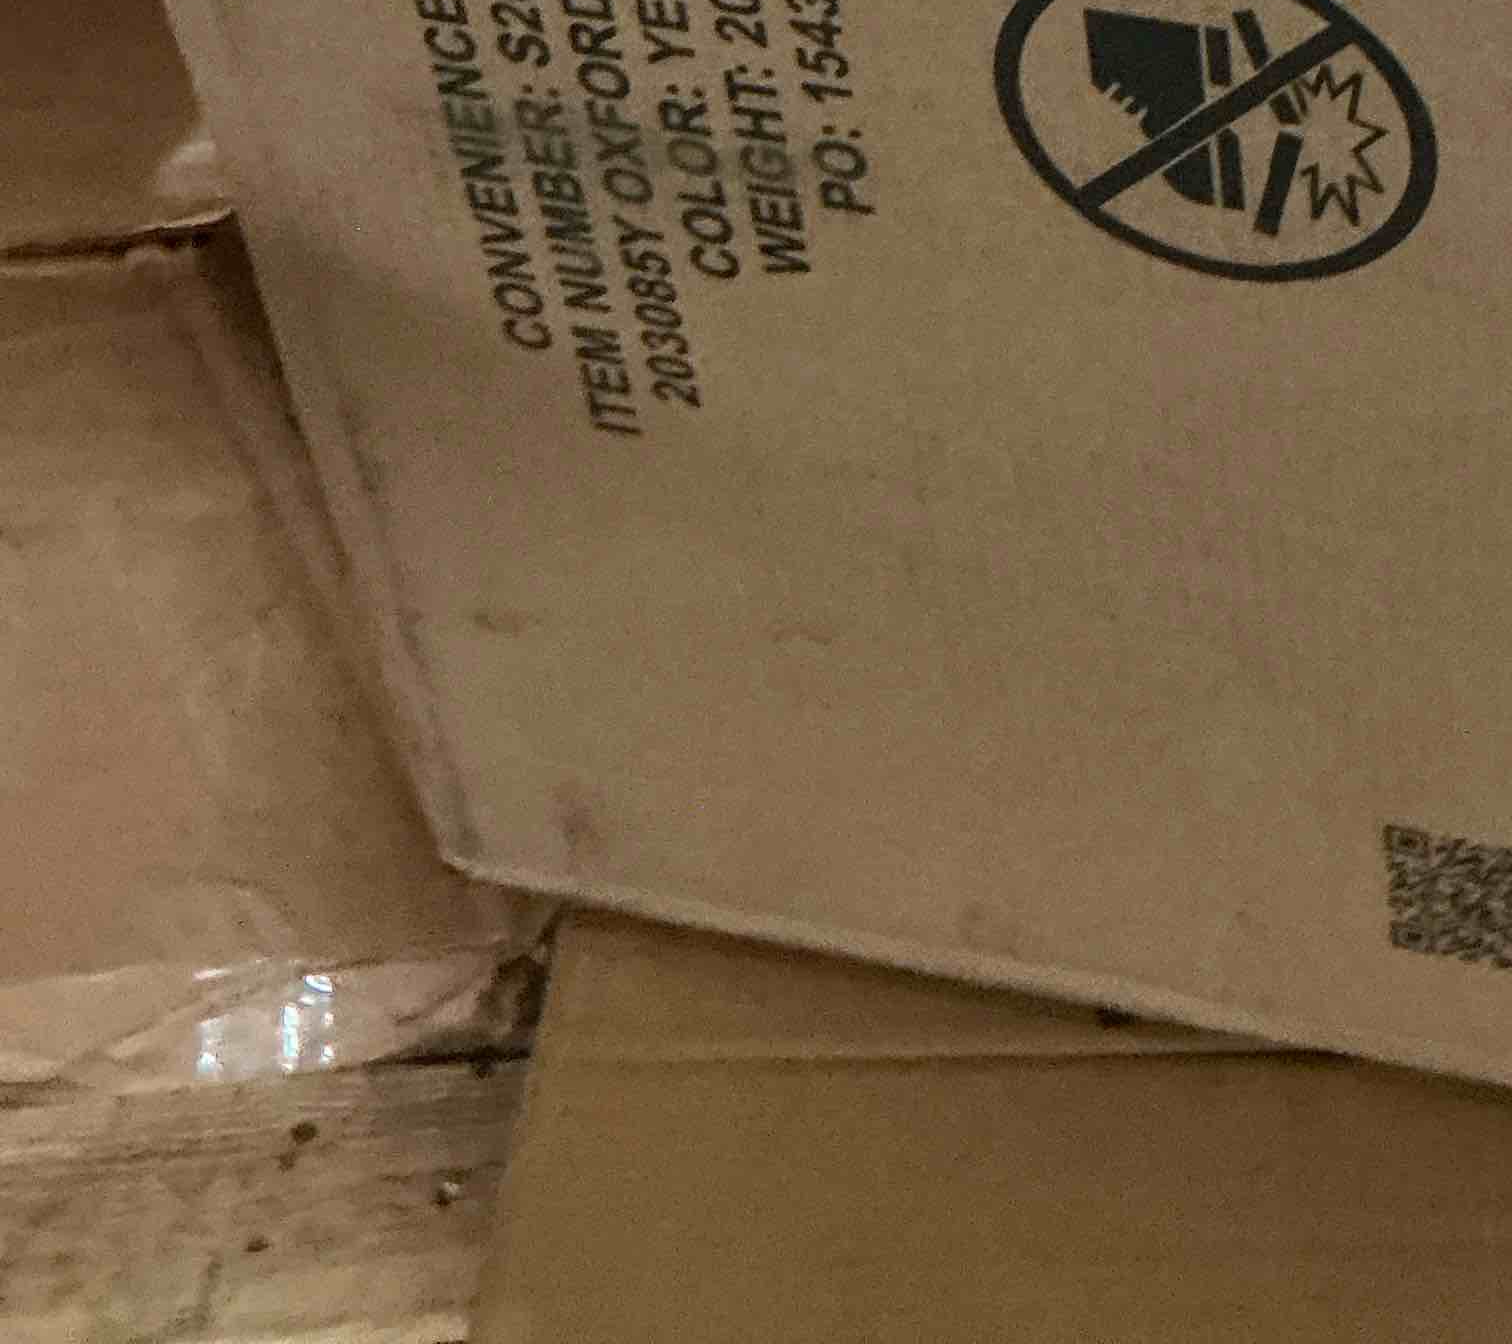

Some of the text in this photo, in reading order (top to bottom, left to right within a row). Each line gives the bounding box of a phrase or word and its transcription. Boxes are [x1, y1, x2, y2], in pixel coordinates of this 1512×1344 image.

[517, 83, 612, 312] NUMBER:
[655, 82, 742, 281] COLOR:
[732, 63, 811, 275] WEIGHT:
[815, 126, 876, 214] PO:
[571, 325, 642, 435] ITEM
[609, 214, 701, 407] 203085Y
